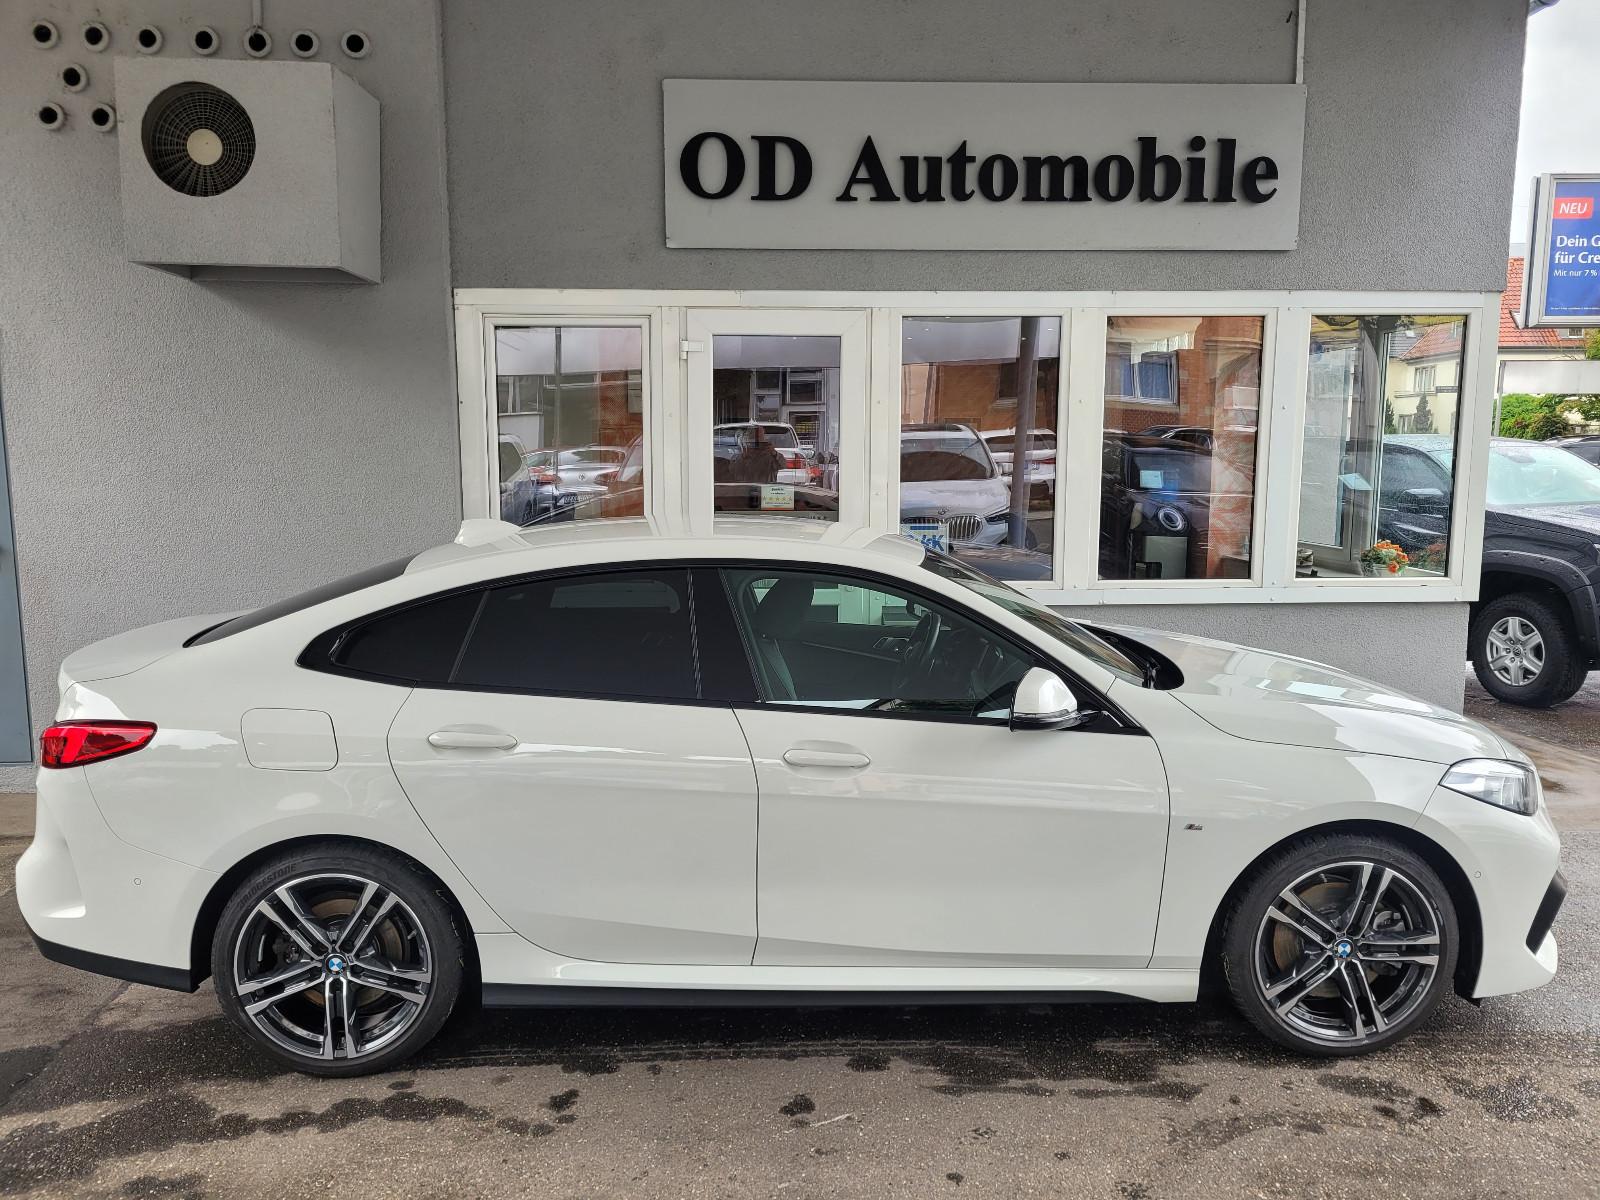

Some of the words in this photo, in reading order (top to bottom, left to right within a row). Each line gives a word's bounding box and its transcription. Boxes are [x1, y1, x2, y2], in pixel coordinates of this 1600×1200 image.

[680, 131, 813, 201] OD
[836, 135, 1279, 204] Automobile
[1559, 202, 1588, 214] NEU
[1556, 235, 1588, 247] Dein
[1554, 251, 1575, 264] für
[1578, 252, 1600, 264] Cre
[1553, 269, 1567, 277] Mit
